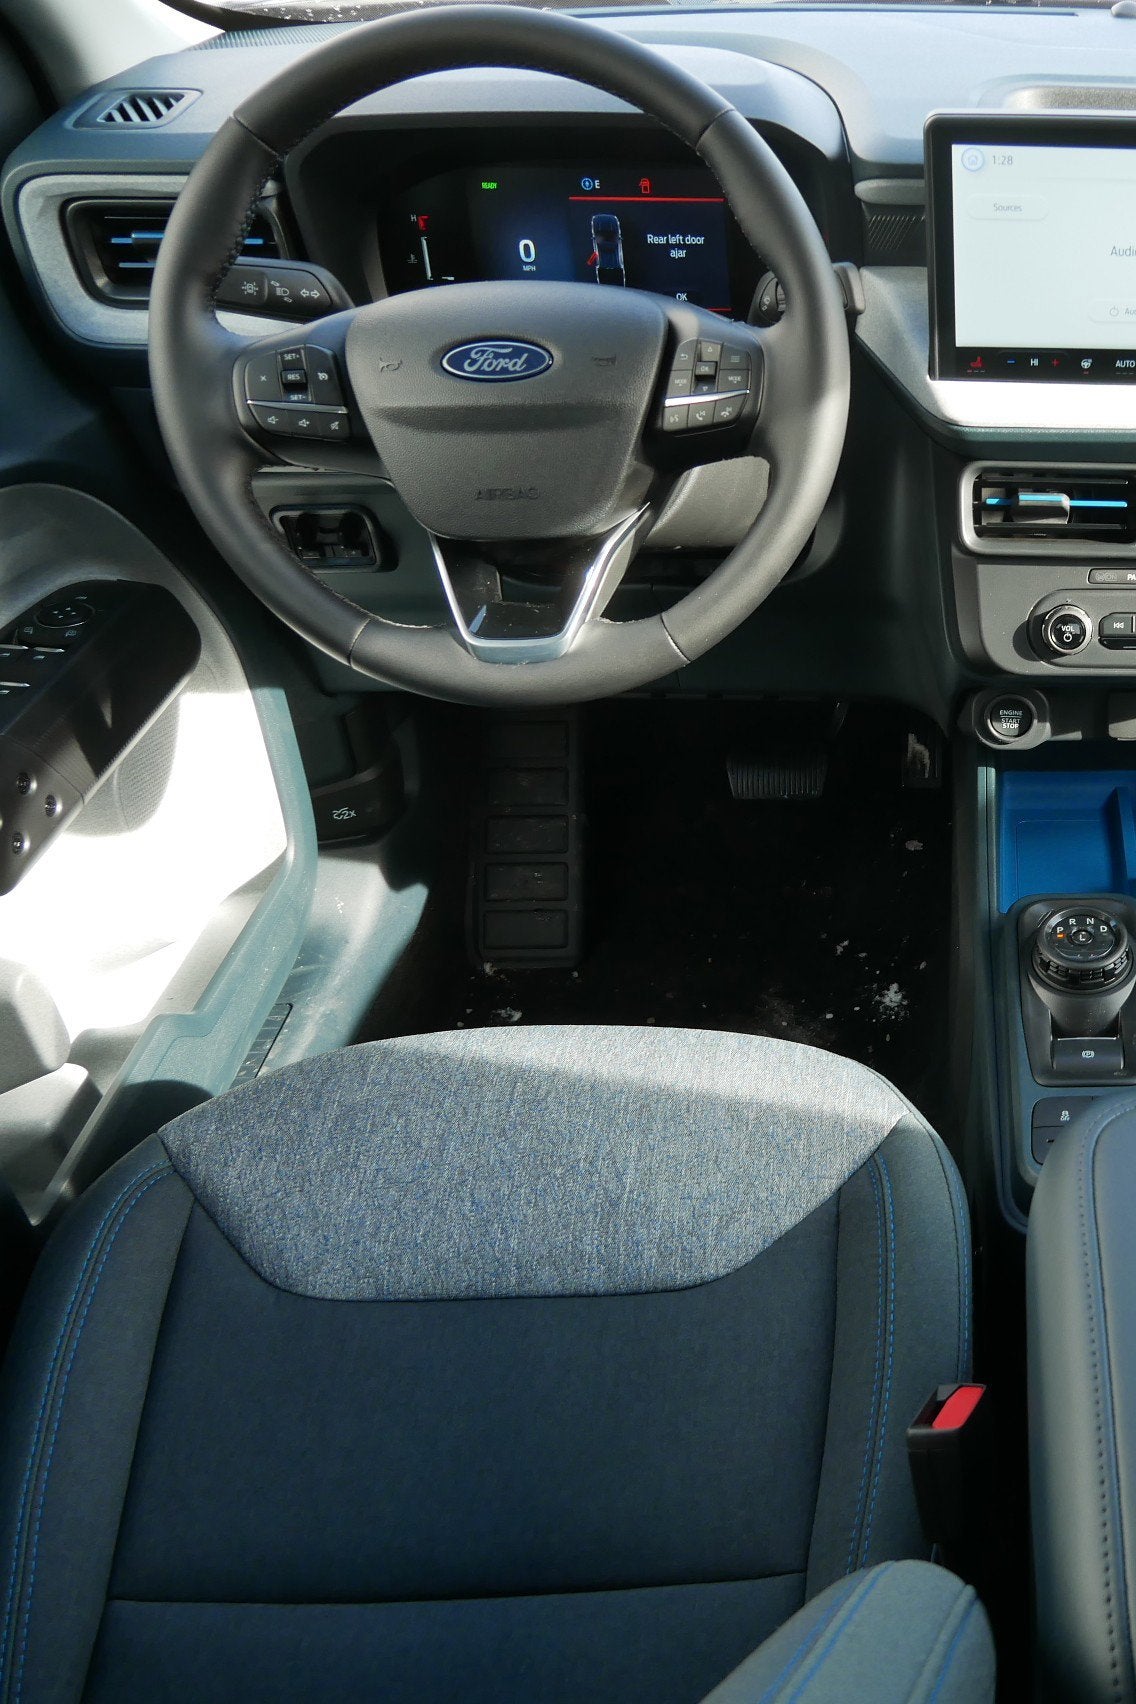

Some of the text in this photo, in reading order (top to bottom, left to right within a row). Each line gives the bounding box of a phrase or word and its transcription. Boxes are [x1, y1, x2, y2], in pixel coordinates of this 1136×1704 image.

[992, 155, 1013, 165] 1:28
[993, 203, 1022, 212] Sources
[646, 234, 705, 244] Rear left door
[519, 239, 536, 263] 0
[670, 248, 687, 259] ajar
[676, 293, 688, 301] OK
[463, 347, 528, 372] Ford
[1030, 358, 1039, 367] HI
[1115, 360, 1136, 368] AUTO
[475, 487, 540, 500] AIRBAG
[1086, 917, 1095, 925] N
[1056, 925, 1108, 934] P D
